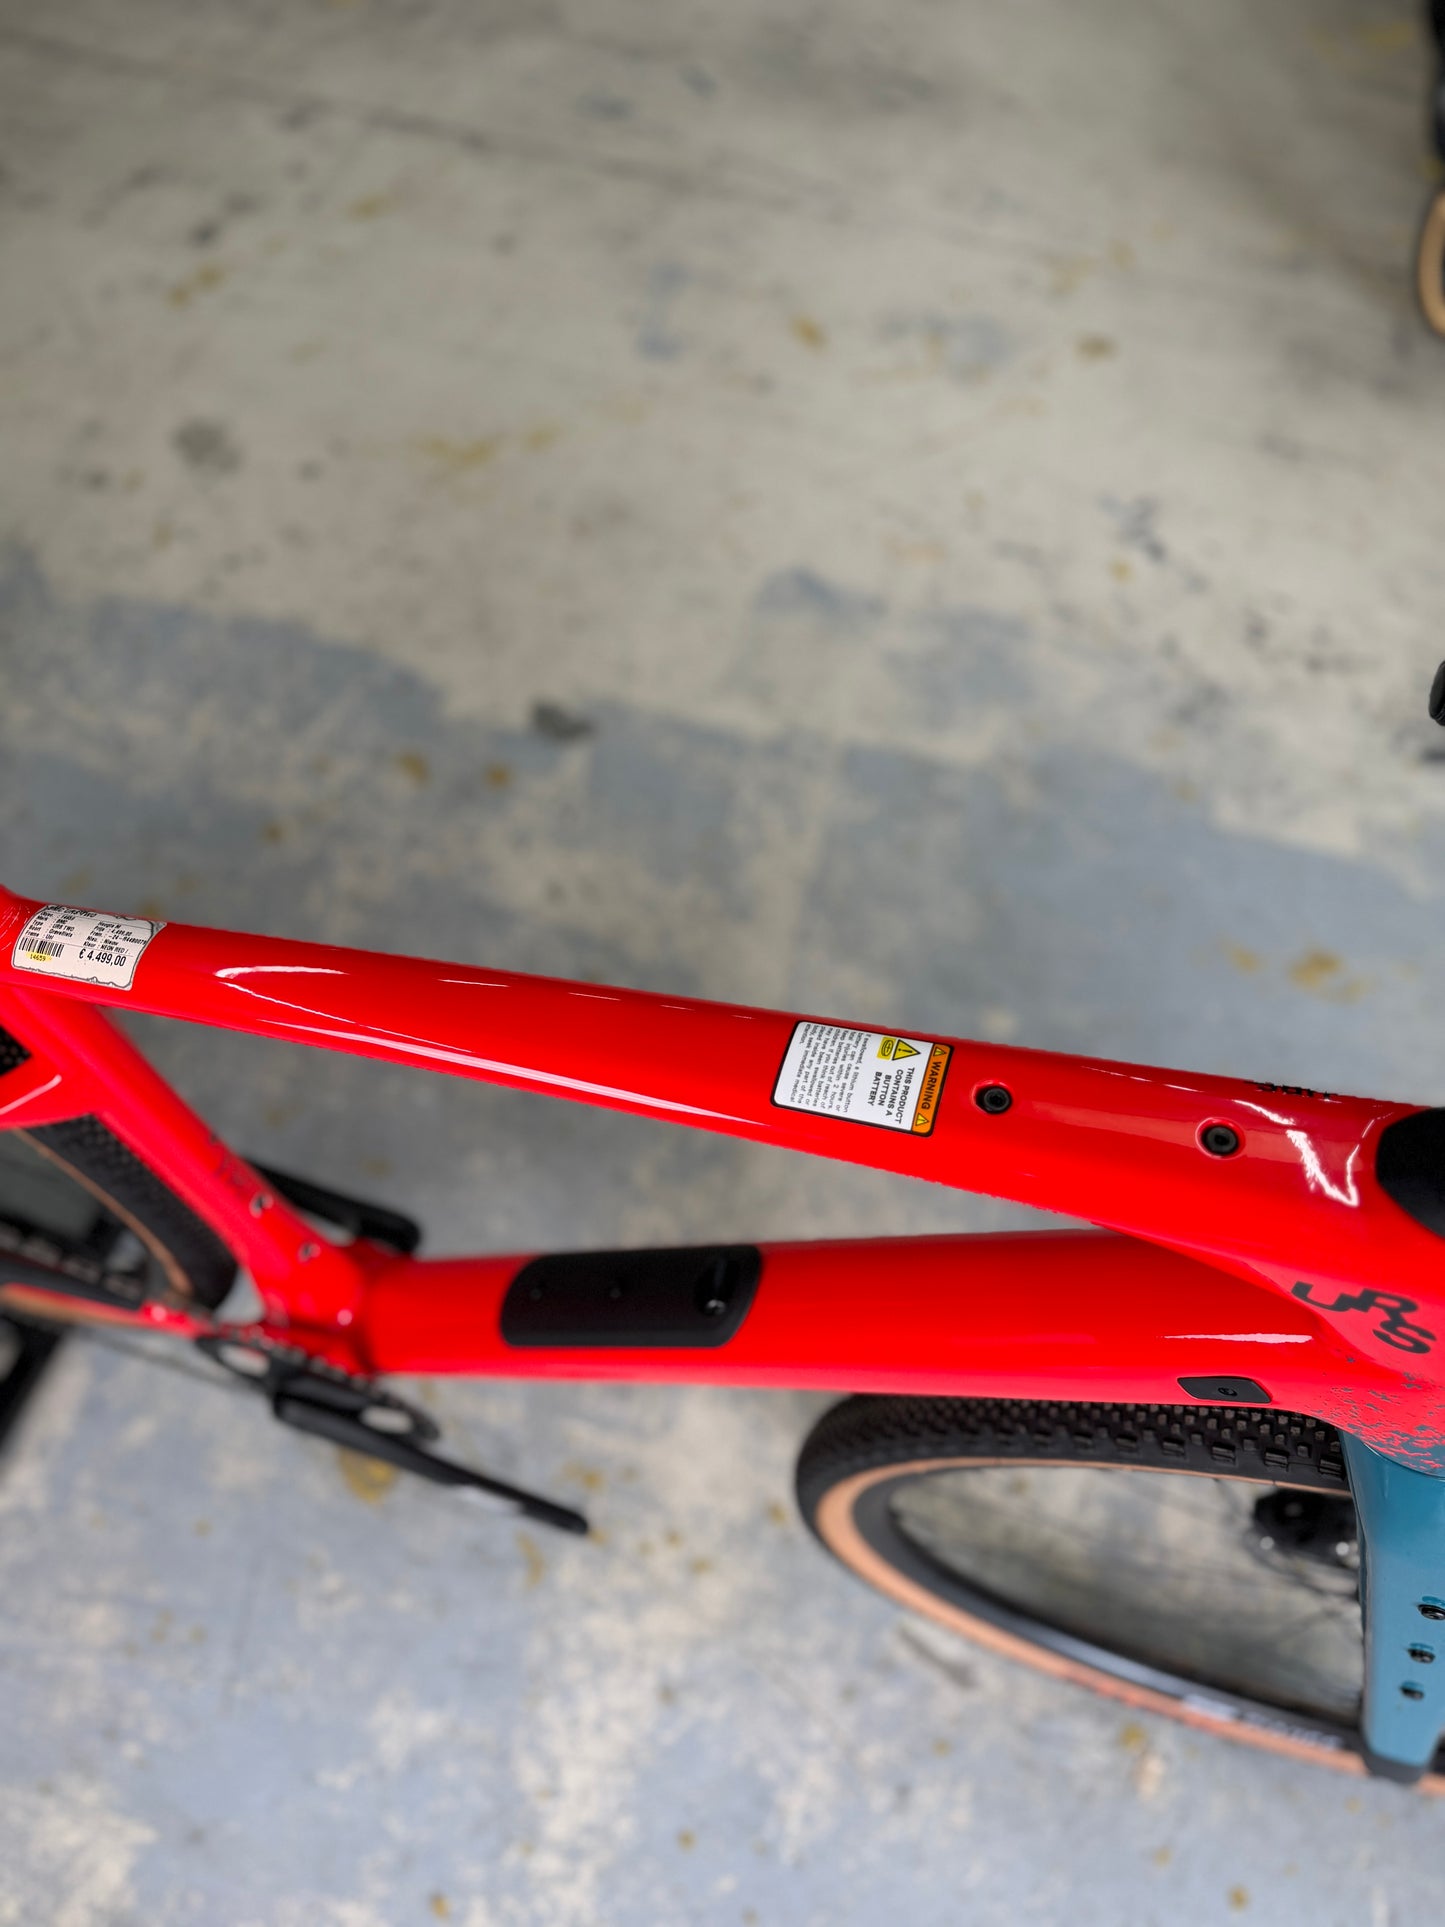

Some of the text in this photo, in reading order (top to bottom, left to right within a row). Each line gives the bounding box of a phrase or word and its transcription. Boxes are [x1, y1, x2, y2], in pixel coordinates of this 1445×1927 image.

[78, 948, 127, 967] € 4.499,00
[805, 1037, 813, 1048] seek
[810, 1042, 820, 1057] inside
[821, 1037, 829, 1049] have
[840, 1043, 851, 1061] injuries
[816, 1051, 824, 1064] been
[823, 1053, 831, 1063] you
[832, 1041, 844, 1064] batteries
[796, 1050, 809, 1077] immediate
[805, 1059, 813, 1068] any
[820, 1064, 828, 1079] think
[835, 1063, 844, 1080] within
[843, 1063, 852, 1079] cause
[801, 1070, 810, 1083] part
[806, 1066, 819, 1096] swallowed
[848, 1071, 858, 1090] lithium
[920, 1060, 941, 1110] WARNING
[788, 1079, 800, 1102] medical
[796, 1093, 804, 1103] the
[811, 1080, 824, 1106] batteries
[821, 1083, 831, 1100] reach
[837, 1082, 847, 1101] severe
[866, 1071, 882, 1106] BATTERY
[877, 1074, 892, 1105] BUTTON
[887, 1069, 904, 1109] CONTAINS
[893, 1066, 914, 1123] THIS PRODUCT
[826, 1091, 836, 1109] hours.
[842, 1092, 852, 1112] button
[1291, 1281, 1437, 1354] URS
